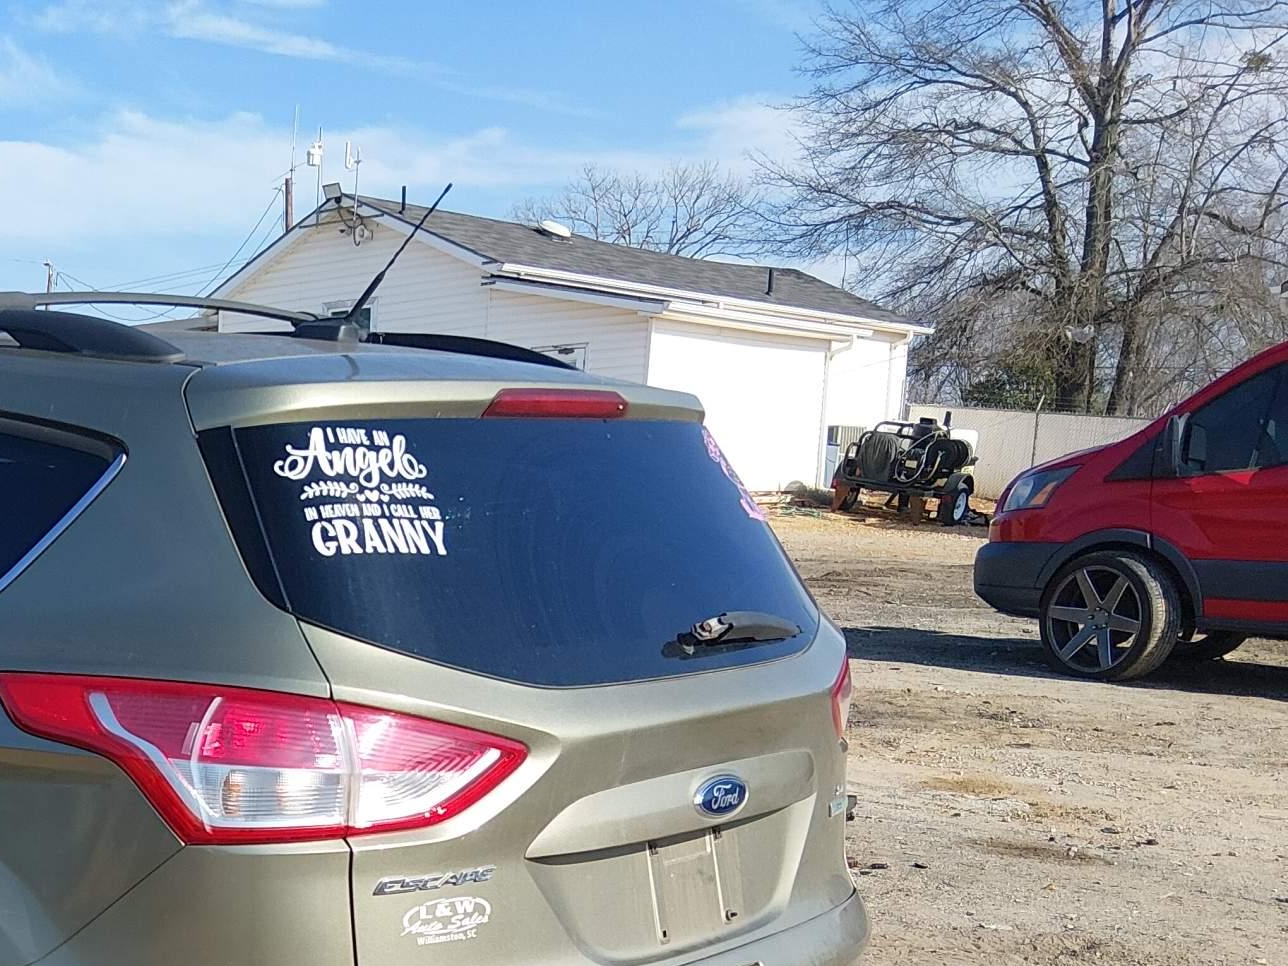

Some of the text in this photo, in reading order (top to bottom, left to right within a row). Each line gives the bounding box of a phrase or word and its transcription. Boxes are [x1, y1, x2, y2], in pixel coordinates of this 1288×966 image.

[327, 427, 391, 446] I HAVE AN
[273, 427, 428, 488] Angel
[304, 503, 441, 521] IN HEAVEN AND I CALL HER
[311, 518, 448, 556] GRANNY
[712, 783, 740, 810] Ford
[372, 864, 496, 896] ESCAPE
[402, 920, 444, 935] Auto
